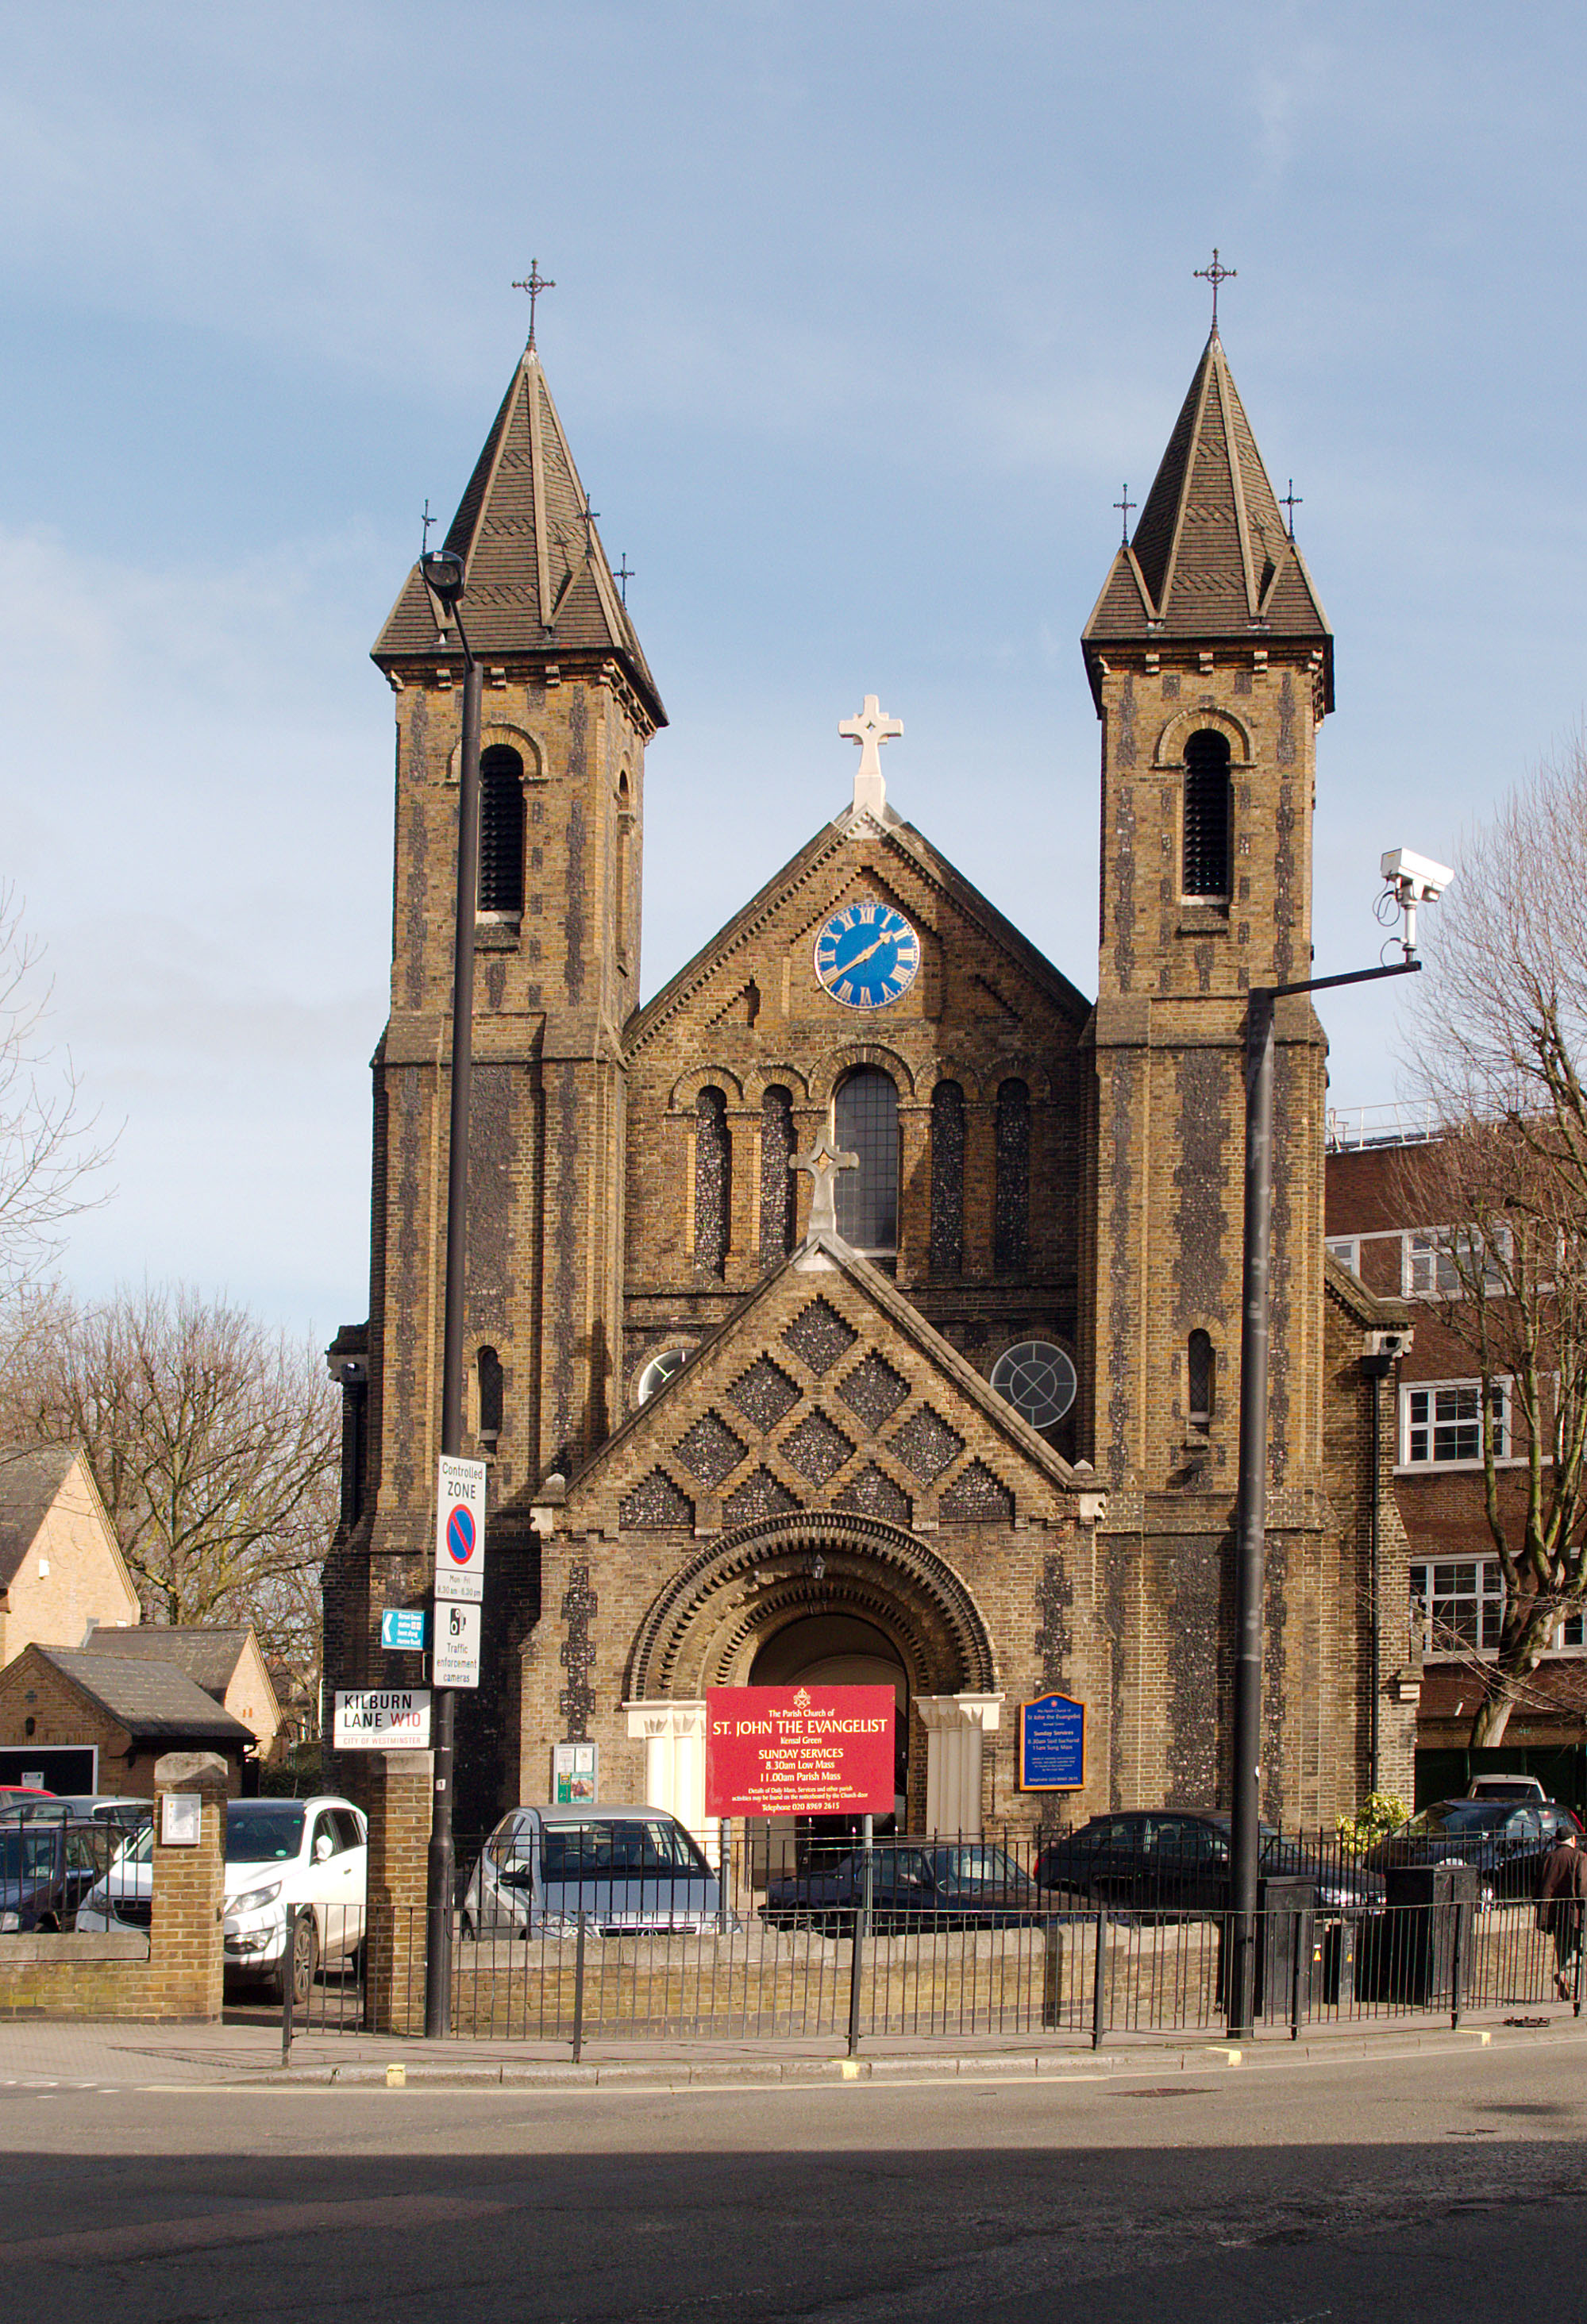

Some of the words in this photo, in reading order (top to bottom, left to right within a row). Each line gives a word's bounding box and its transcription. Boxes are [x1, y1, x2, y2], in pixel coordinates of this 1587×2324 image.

[442, 1462, 483, 1480] Controlled
[448, 1481, 476, 1499] ZONE
[449, 1574, 460, 1583] Mon
[446, 1642, 468, 1654] Traffic
[437, 1657, 477, 1669] enforcement
[444, 1674, 470, 1683] cameras
[345, 1694, 412, 1709] KILBURN
[783, 1709, 802, 1717] Parish
[827, 1708, 835, 1717] of
[345, 1713, 383, 1728] LANE
[390, 1713, 421, 1727] W10
[713, 1721, 731, 1735] ST.
[736, 1721, 772, 1737] JOHN
[776, 1721, 803, 1733] THE
[807, 1719, 888, 1733] EVANGELIST
[758, 1749, 799, 1759] SUNDAY
[800, 1748, 844, 1759] SERVICES
[765, 1760, 795, 1770] 8.30am
[797, 1760, 814, 1770] Low
[815, 1759, 835, 1769] Mass
[761, 1772, 795, 1783] 11.00am
[796, 1771, 819, 1781] Parish
[821, 1771, 842, 1781] Mass
[762, 1804, 791, 1813] Telephone
[823, 1802, 839, 1810] 2615
